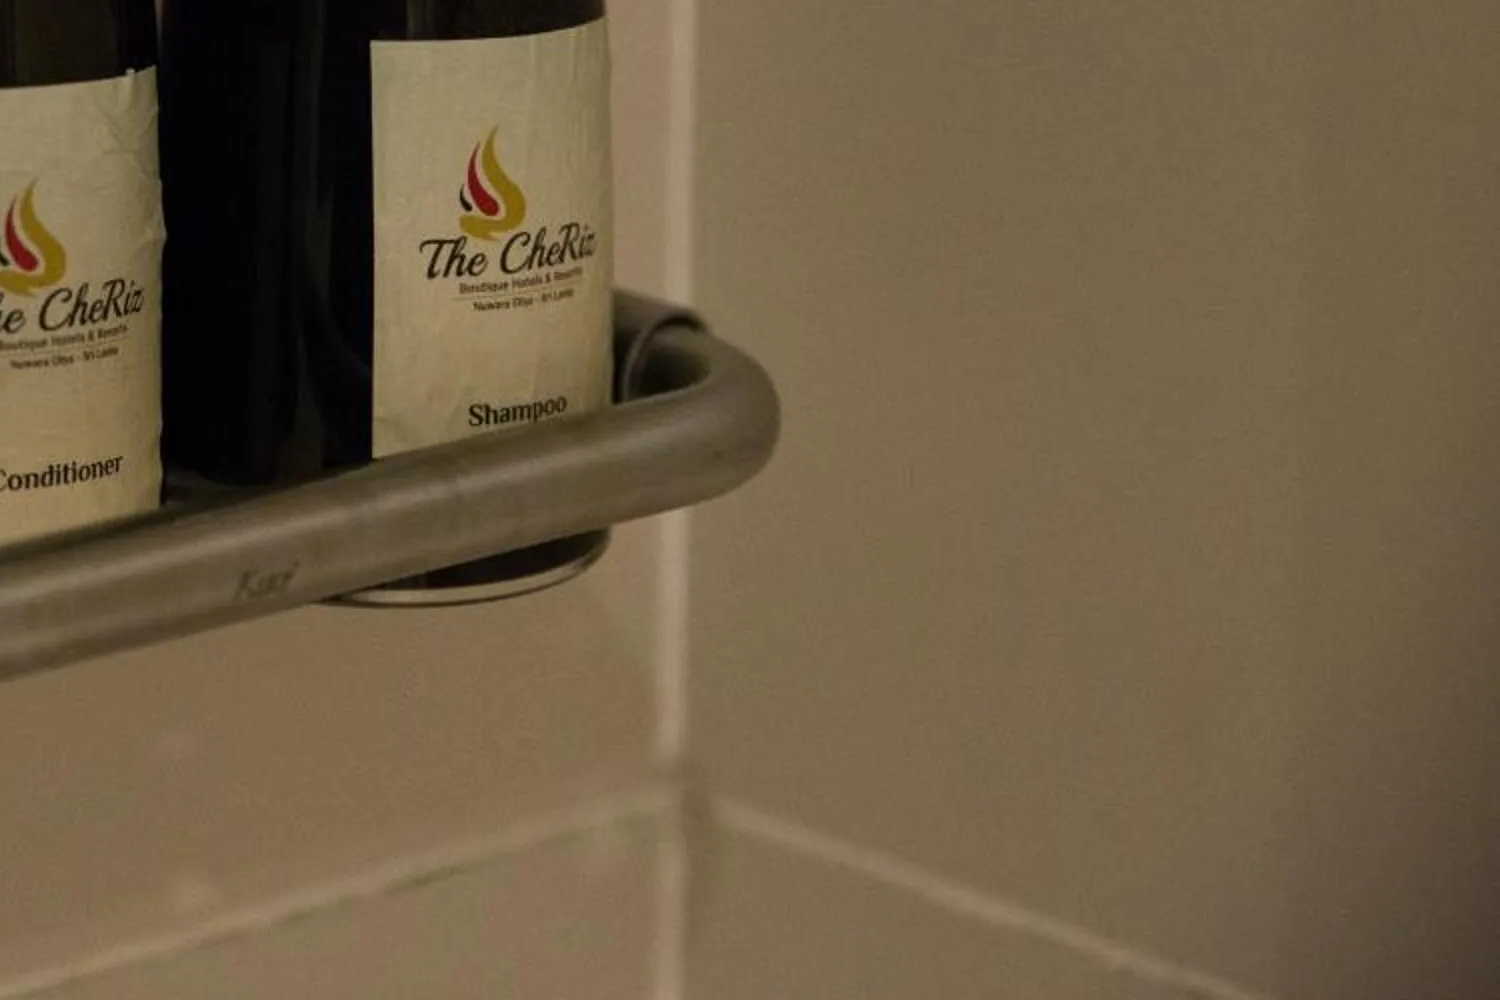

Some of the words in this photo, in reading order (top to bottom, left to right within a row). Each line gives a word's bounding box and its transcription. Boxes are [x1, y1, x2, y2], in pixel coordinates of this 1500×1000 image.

[419, 235, 489, 280] The
[38, 278, 145, 331] CheRiz
[468, 396, 568, 428] Shampoo
